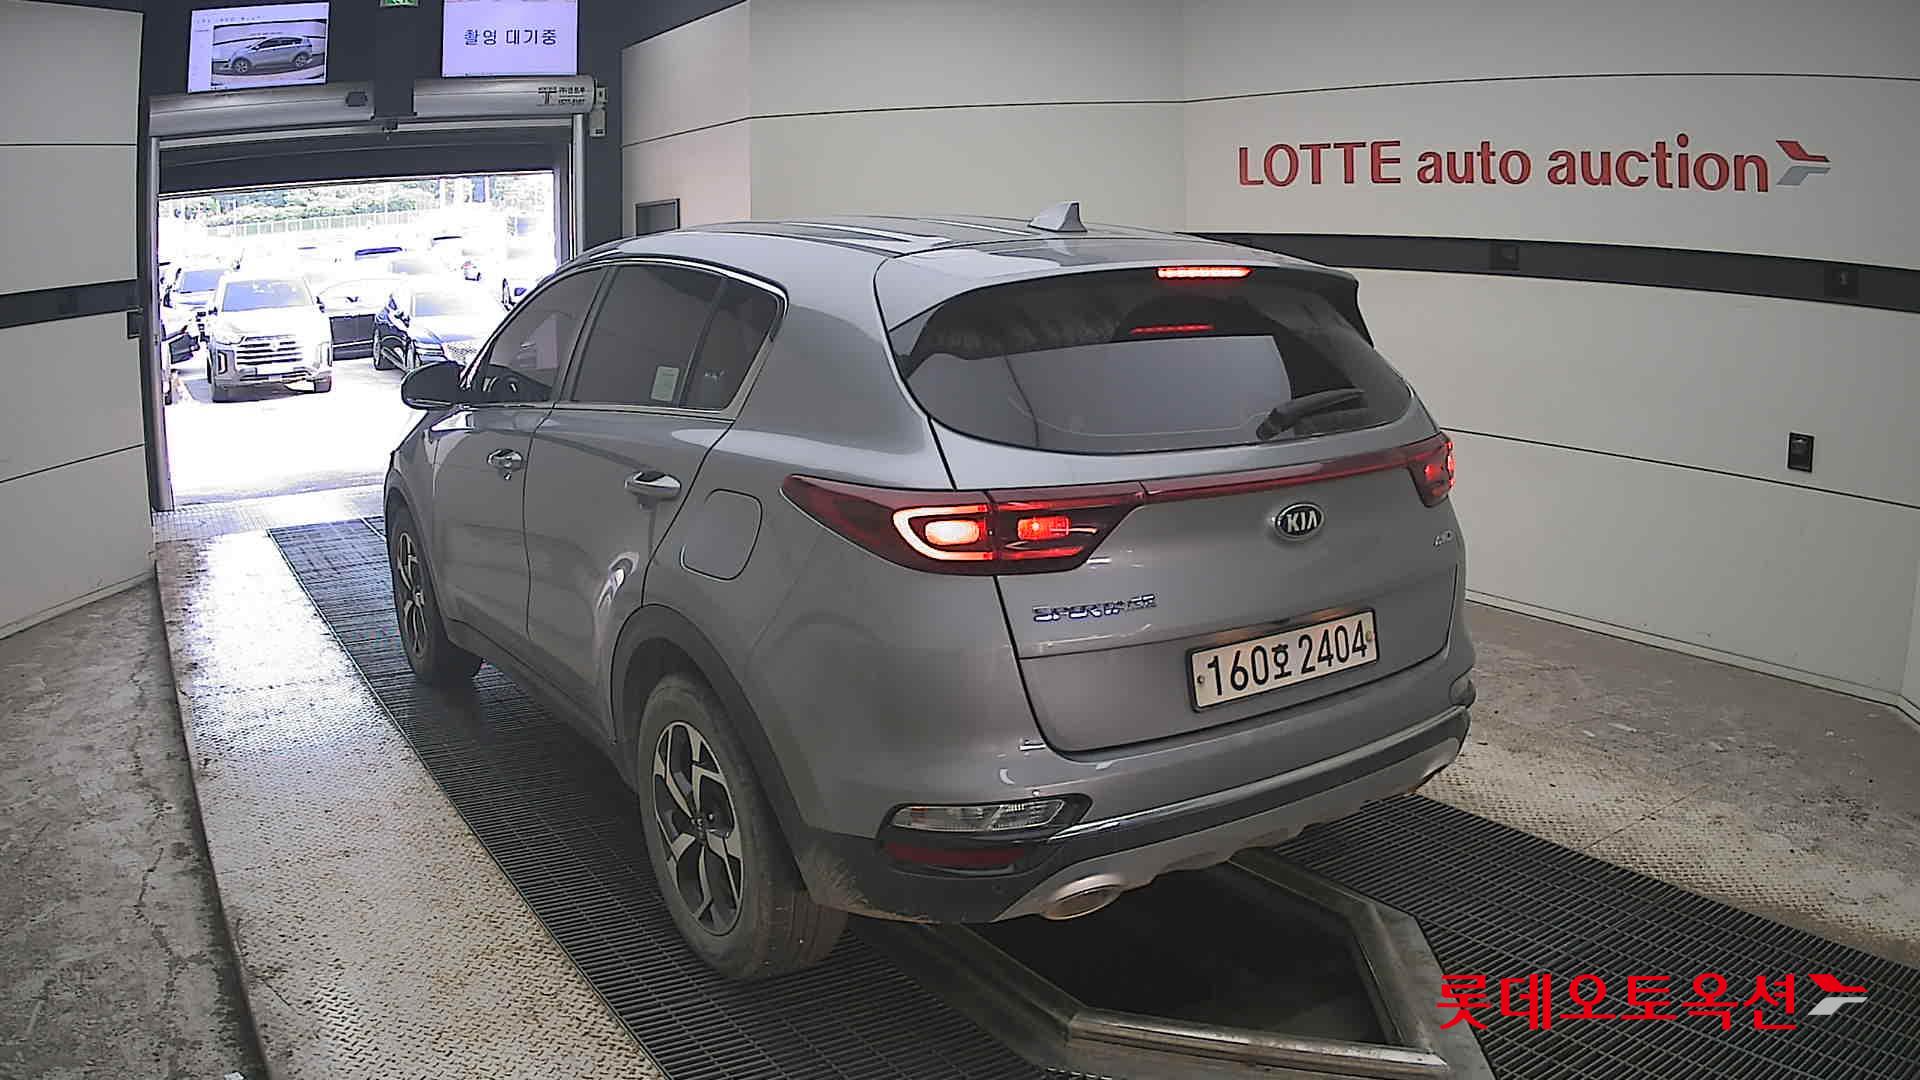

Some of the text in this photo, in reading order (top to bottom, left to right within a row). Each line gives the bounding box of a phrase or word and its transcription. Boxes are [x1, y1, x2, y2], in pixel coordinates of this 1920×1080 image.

[505, 29, 557, 46] 대기중
[1238, 133, 1769, 193] LOTTE auto auction
[1286, 509, 1318, 533] KIA
[1207, 619, 1368, 696] 160호 2404
